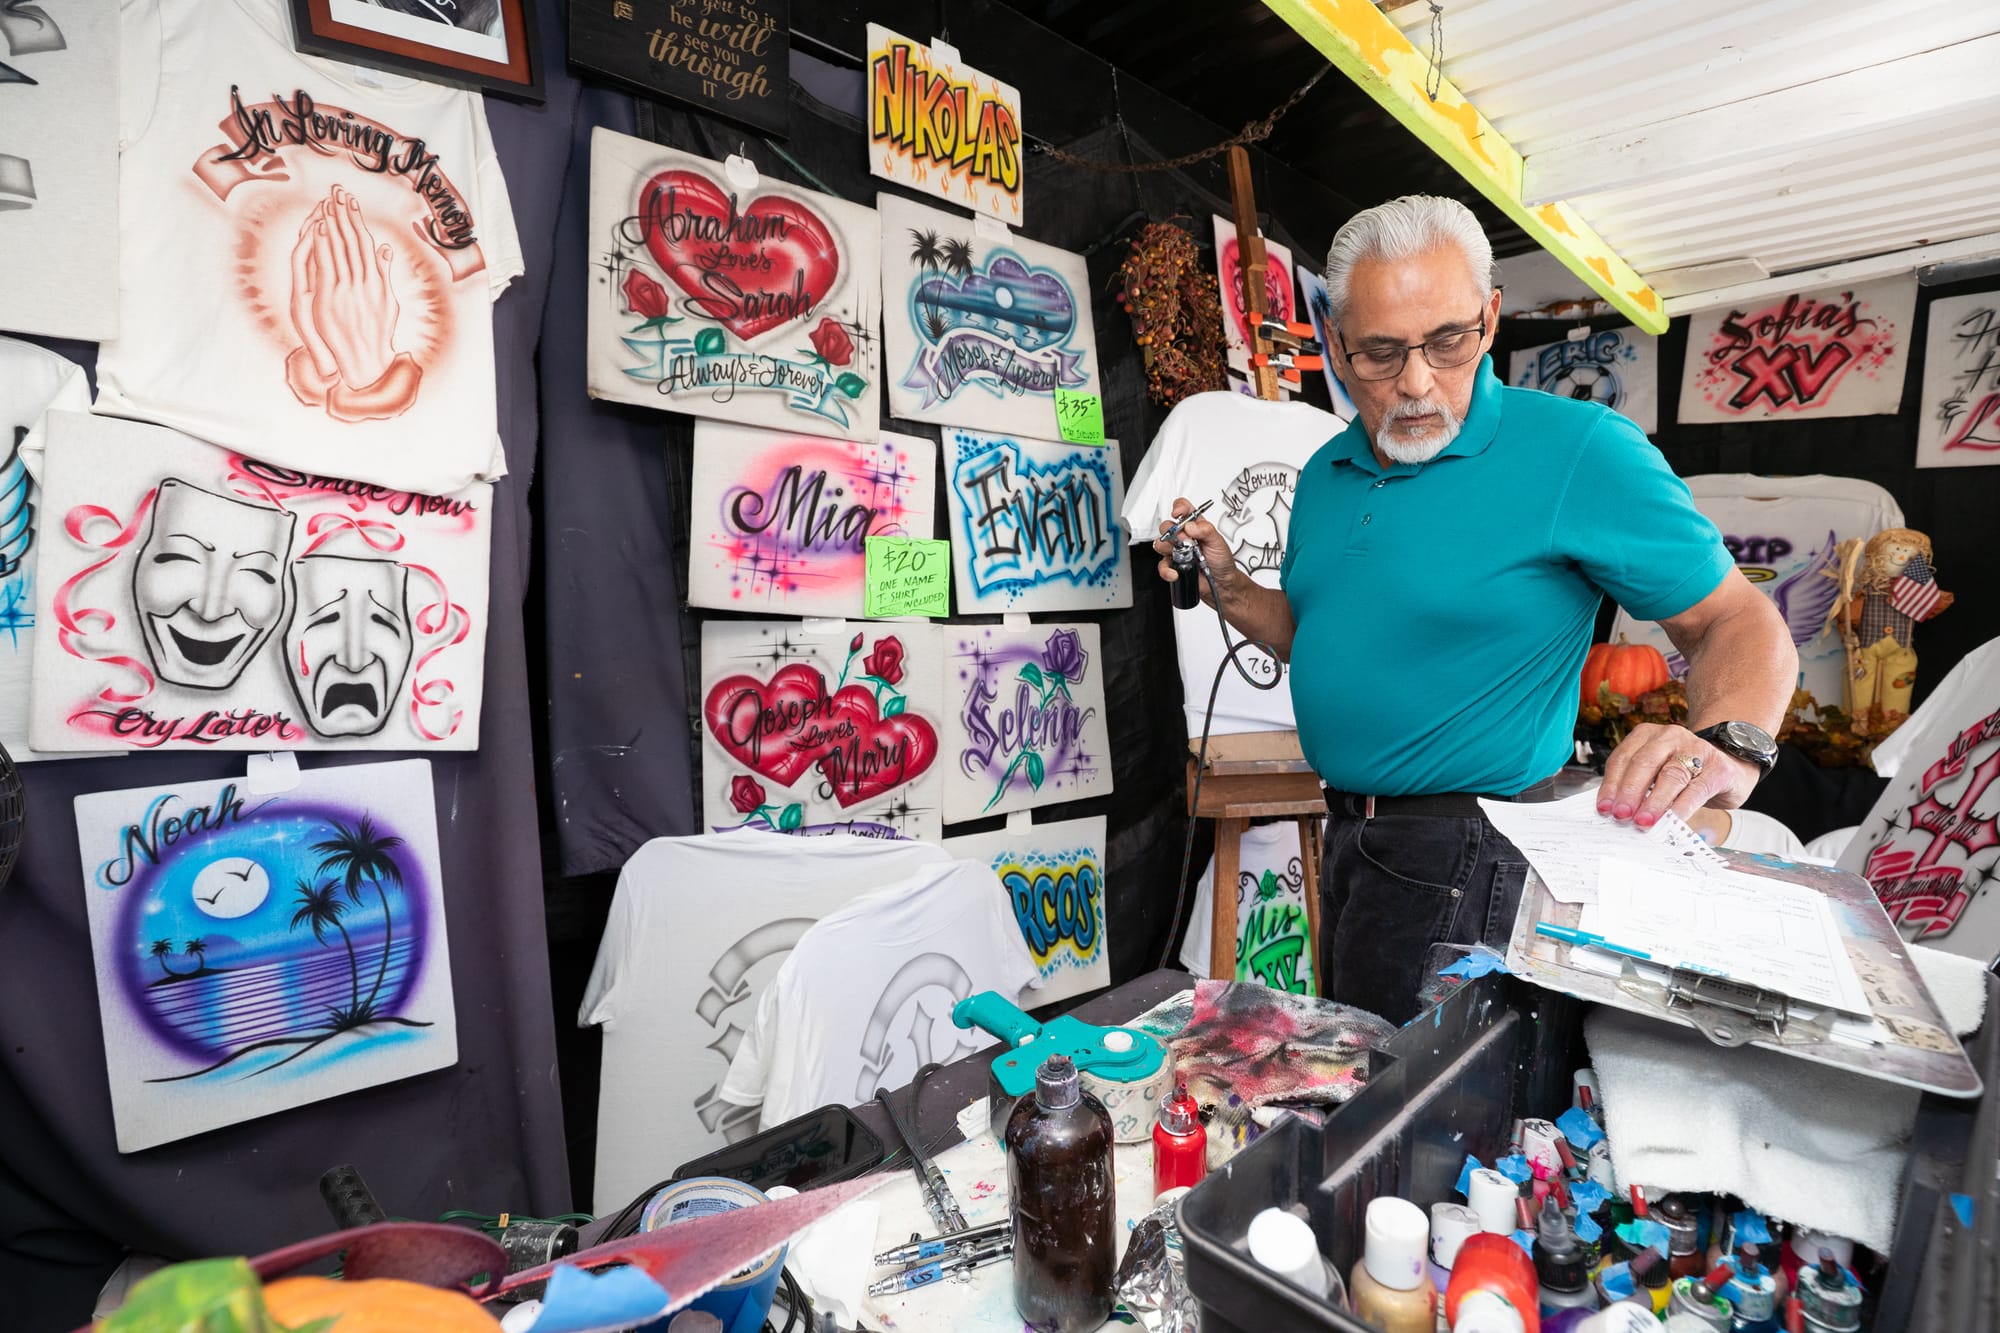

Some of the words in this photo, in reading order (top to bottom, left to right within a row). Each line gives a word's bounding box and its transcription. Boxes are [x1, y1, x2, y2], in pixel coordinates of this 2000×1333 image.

[670, 5, 694, 29] he
[700, 18, 771, 56] will
[740, 5, 759, 24] to
[764, 13, 777, 31] it
[645, 28, 772, 100] through
[684, 34, 709, 53] see
[713, 45, 740, 66] you
[703, 80, 718, 97] IT
[873, 43, 1021, 193] NIKOLAS
[217, 85, 282, 163] In
[274, 90, 393, 172] Loving
[391, 139, 477, 250] Memory
[621, 192, 791, 246] Abraham
[697, 246, 774, 270] Loves
[684, 267, 815, 321] Sarah
[657, 354, 746, 403] Always
[759, 354, 829, 399] Forever
[1539, 331, 1621, 385] ERIC
[1728, 341, 1852, 409] XV
[731, 465, 881, 549] Mia
[1222, 489, 1242, 518] In
[1237, 467, 1288, 497] Loving
[880, 578, 898, 592] ONE
[904, 574, 938, 587] NAME
[98, 706, 184, 747] Cry
[181, 708, 294, 742] Later
[728, 674, 836, 765] Joseph
[791, 717, 858, 750] Loves
[963, 679, 1088, 774] Selena
[816, 736, 909, 800] Mary
[106, 783, 256, 887] Noah
[1237, 904, 1301, 963] Mis
[1250, 935, 1306, 994] XV
[673, 1200, 690, 1213] 3M
